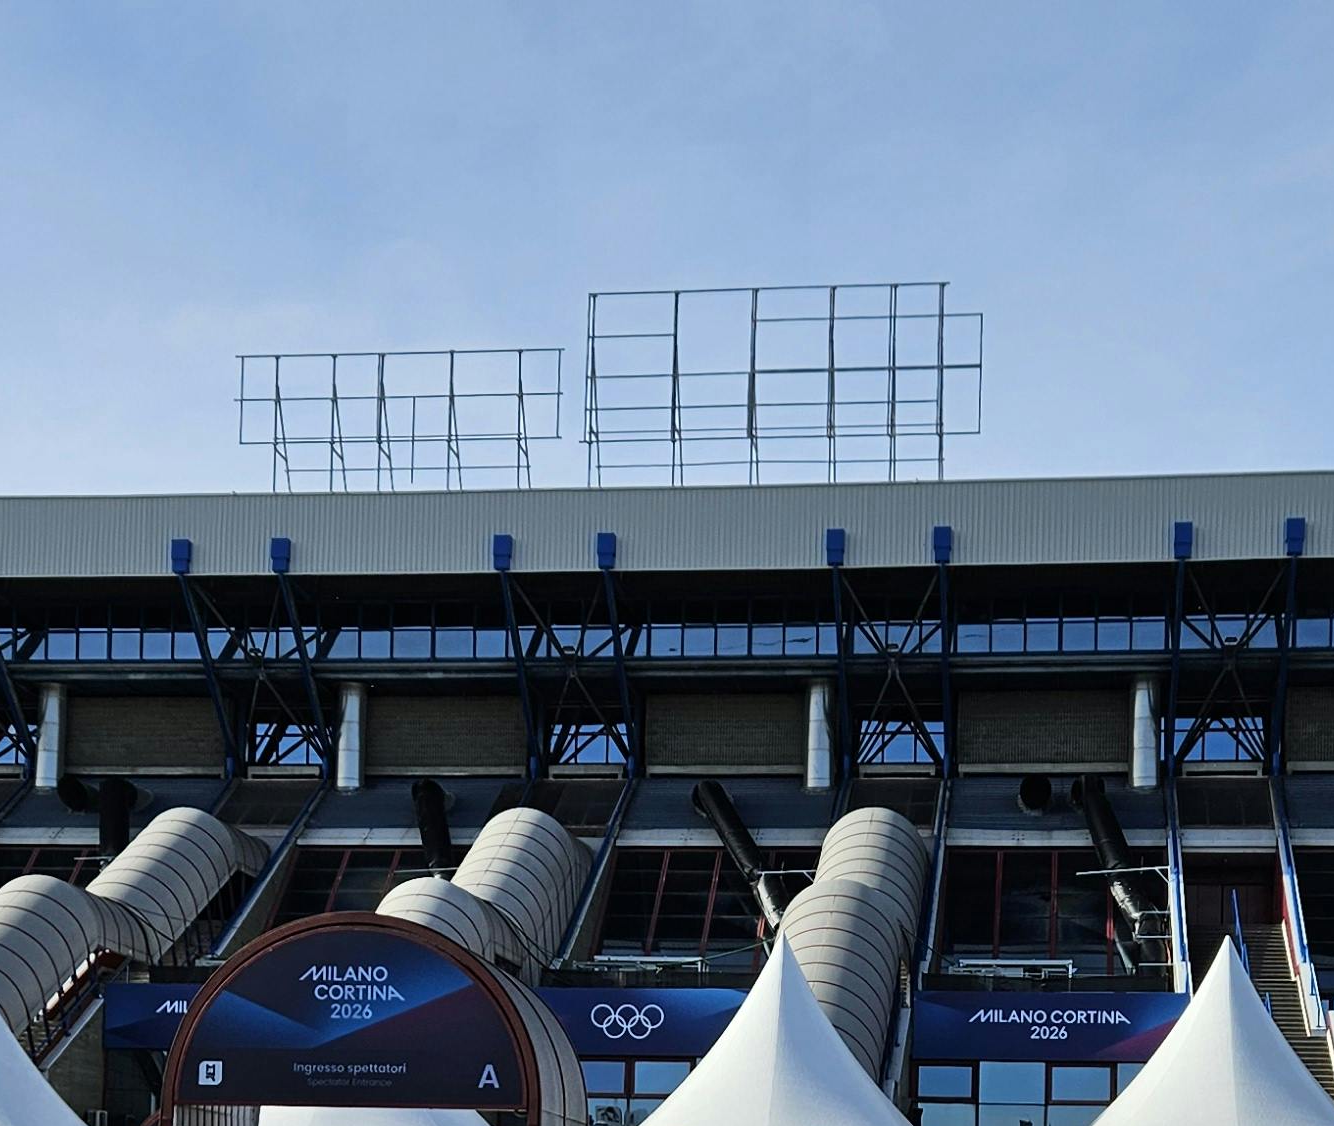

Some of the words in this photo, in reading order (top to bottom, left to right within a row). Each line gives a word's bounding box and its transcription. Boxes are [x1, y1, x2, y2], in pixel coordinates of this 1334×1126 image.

[299, 965, 388, 982] MILANO
[314, 984, 405, 1001] CORTINA
[155, 1000, 188, 1014] MIL
[330, 1003, 373, 1019] 2026
[968, 1009, 1047, 1024] MILANO
[1050, 1010, 1131, 1025] CORTINA
[1030, 1025, 1068, 1040] 2026
[293, 1062, 345, 1076] Ingresso
[347, 1062, 407, 1076] spettatori
[478, 1064, 500, 1089] A
